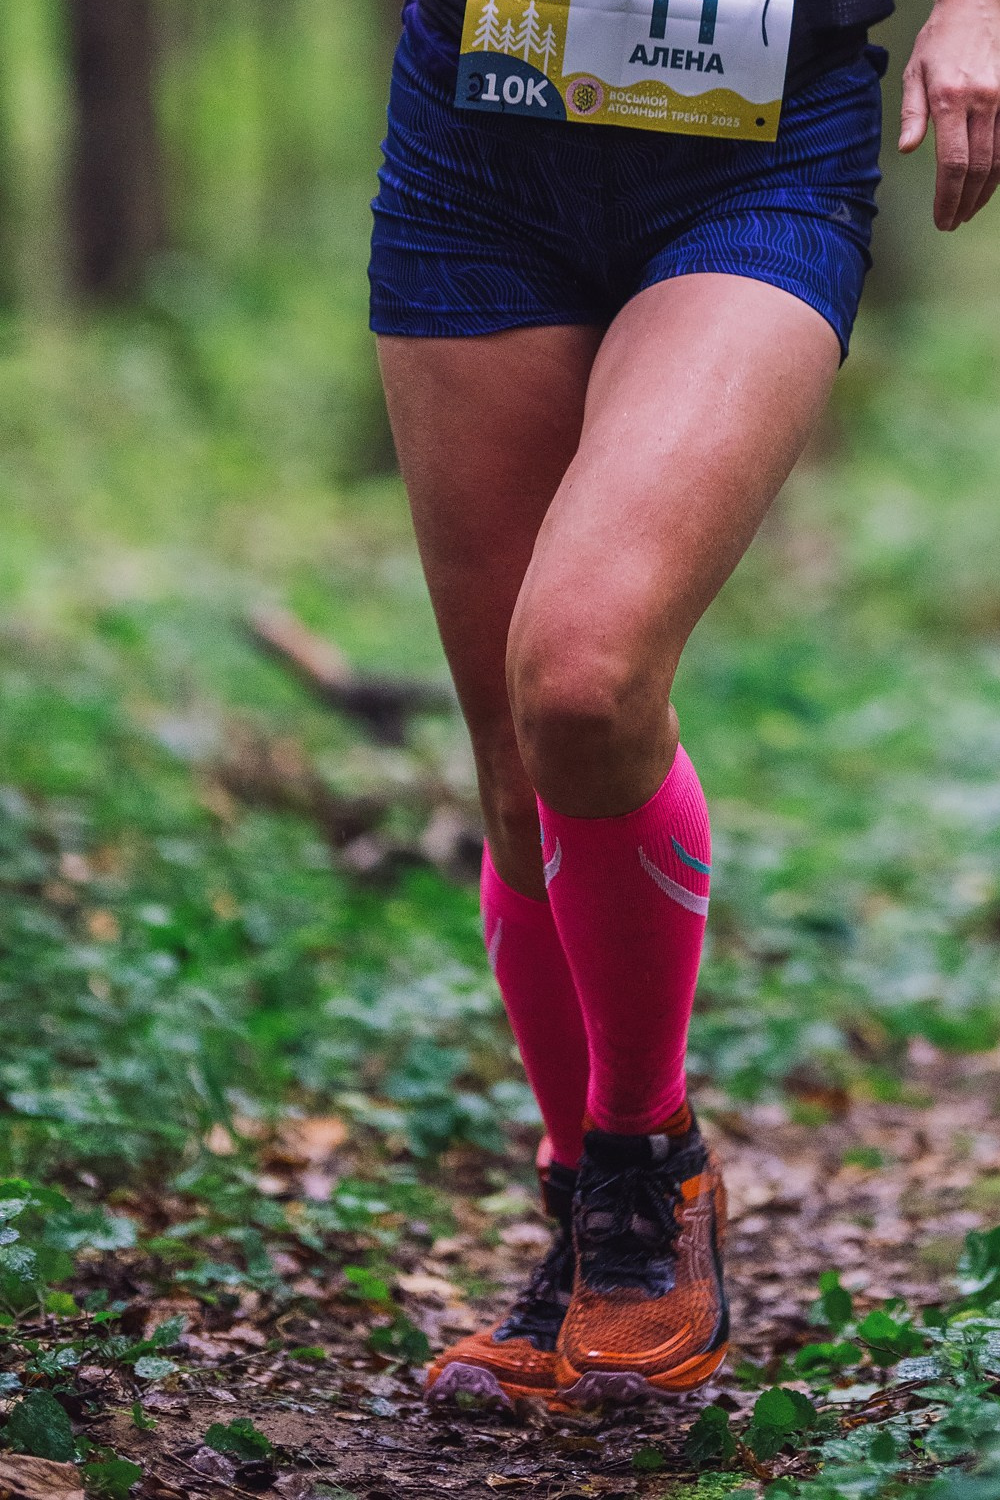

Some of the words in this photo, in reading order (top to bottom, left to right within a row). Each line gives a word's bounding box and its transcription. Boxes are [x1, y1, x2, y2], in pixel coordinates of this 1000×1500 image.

[629, 45, 724, 75] АЛЕНА
[609, 91, 668, 107] ВОСЬМОЙ
[608, 103, 667, 119] АТОМНЫЙ
[671, 111, 707, 125] ТРЕЙЛ
[712, 116, 741, 128] 2025
